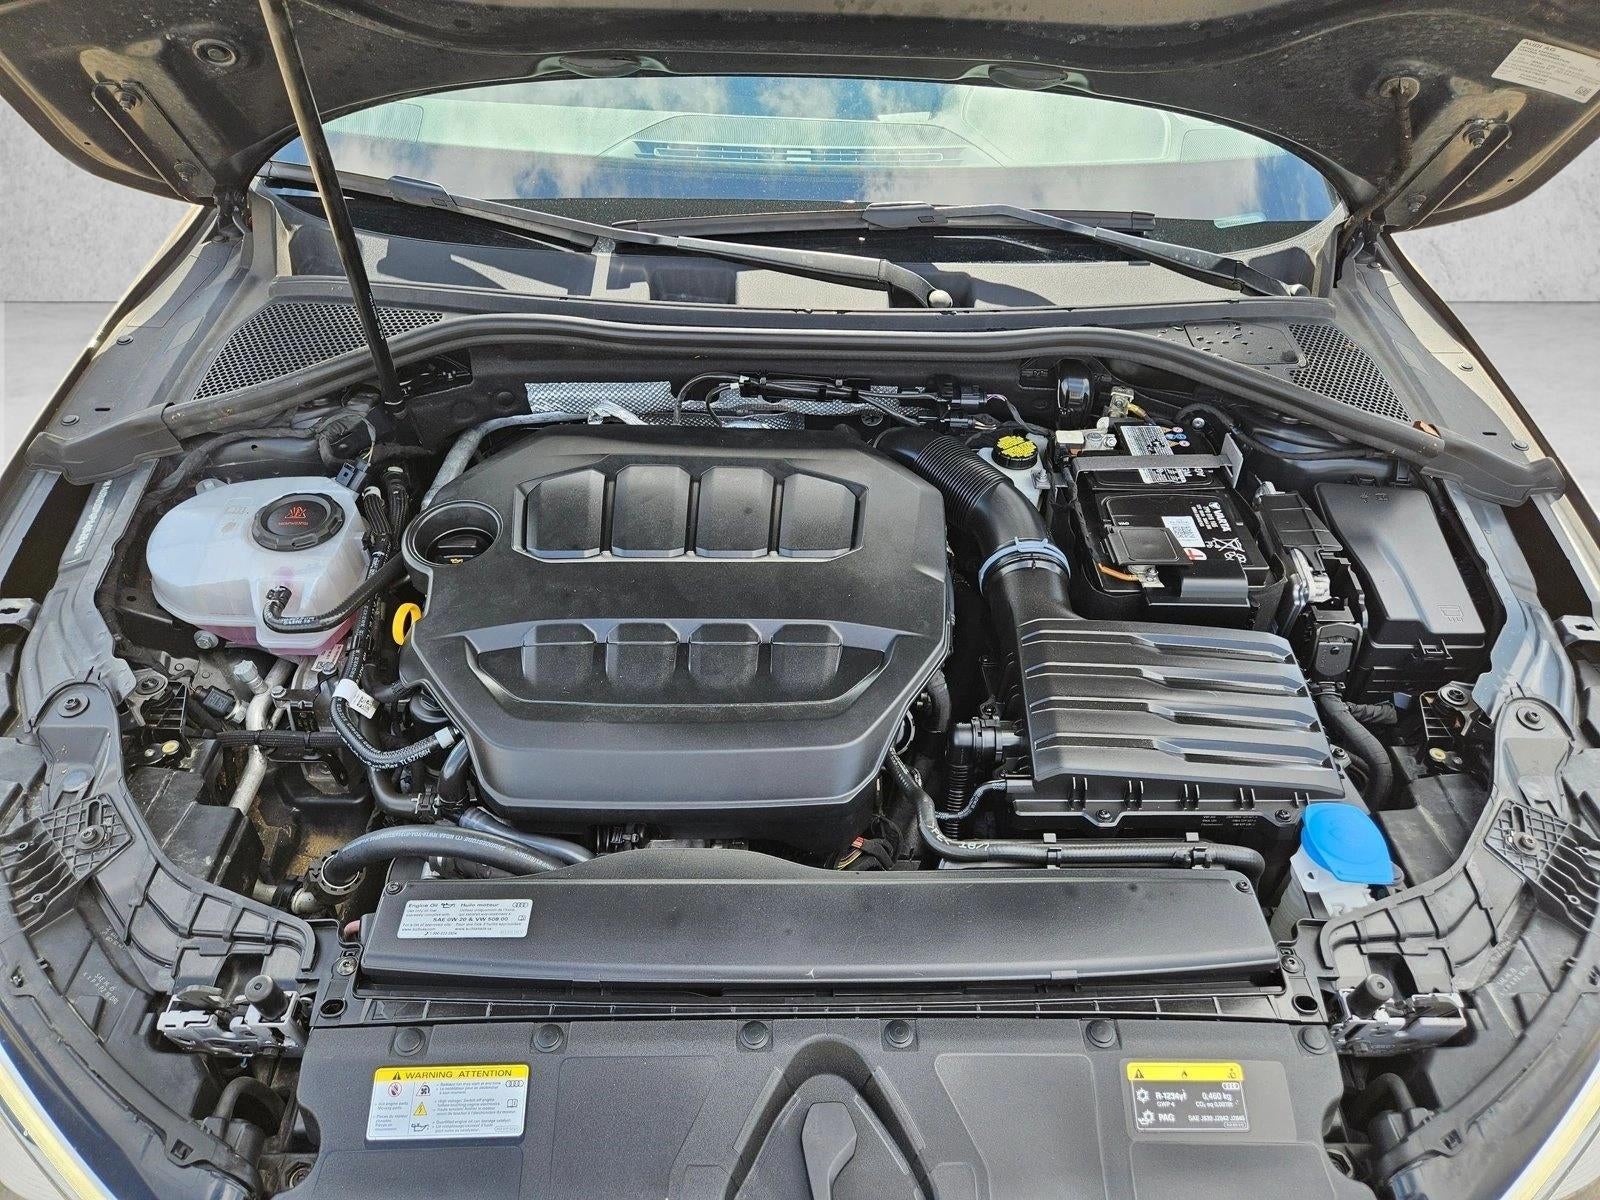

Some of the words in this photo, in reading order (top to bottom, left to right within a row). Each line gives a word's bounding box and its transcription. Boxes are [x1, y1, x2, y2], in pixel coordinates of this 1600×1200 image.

[1213, 509, 1232, 533] VARTA
[405, 1070, 453, 1079] WARNING
[458, 1069, 512, 1078] ATTENTION
[1155, 1089, 1187, 1102] R-1234yf
[1222, 1091, 1232, 1101] kg
[1158, 1113, 1176, 1121] PAG
